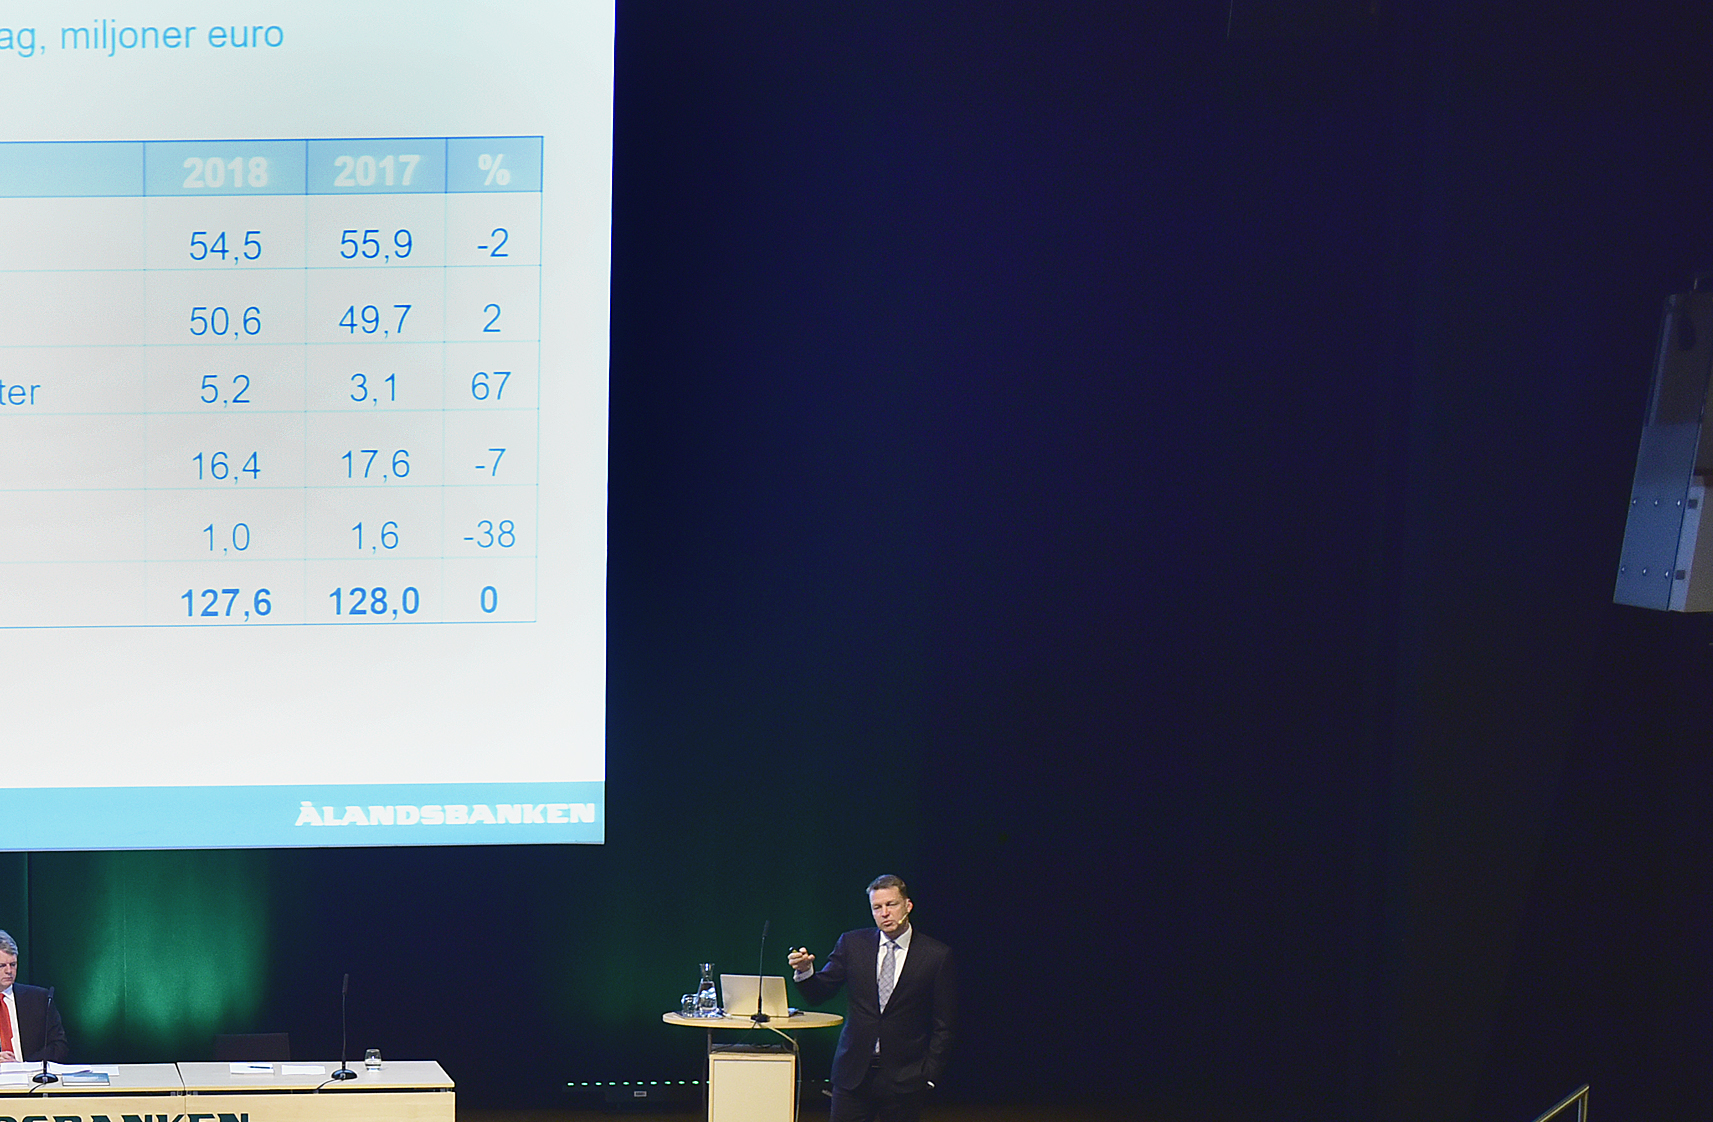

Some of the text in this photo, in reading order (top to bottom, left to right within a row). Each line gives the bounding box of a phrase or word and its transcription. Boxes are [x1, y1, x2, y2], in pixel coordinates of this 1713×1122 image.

[61, 18, 197, 58] miljoner
[207, 25, 285, 49] euro
[182, 156, 269, 188] 2018
[333, 153, 421, 187] 2017
[477, 153, 512, 186] %
[189, 230, 262, 263] 54,5
[340, 228, 413, 264] 55,9
[476, 227, 509, 258] -2
[189, 306, 262, 340] 50,6
[338, 304, 413, 338] 49,7
[482, 303, 502, 333] 2
[200, 374, 251, 408] 5,2
[350, 372, 396, 406] 3,1
[471, 371, 512, 401] 67
[192, 450, 262, 485] 16,4
[341, 449, 411, 482] 17,6
[474, 447, 507, 477] -7
[203, 522, 251, 556] 1,0
[351, 520, 399, 554] 1,6
[463, 519, 516, 549] -38
[181, 587, 272, 623] 127,6
[329, 586, 420, 621] 128,0
[480, 585, 498, 614] 0
